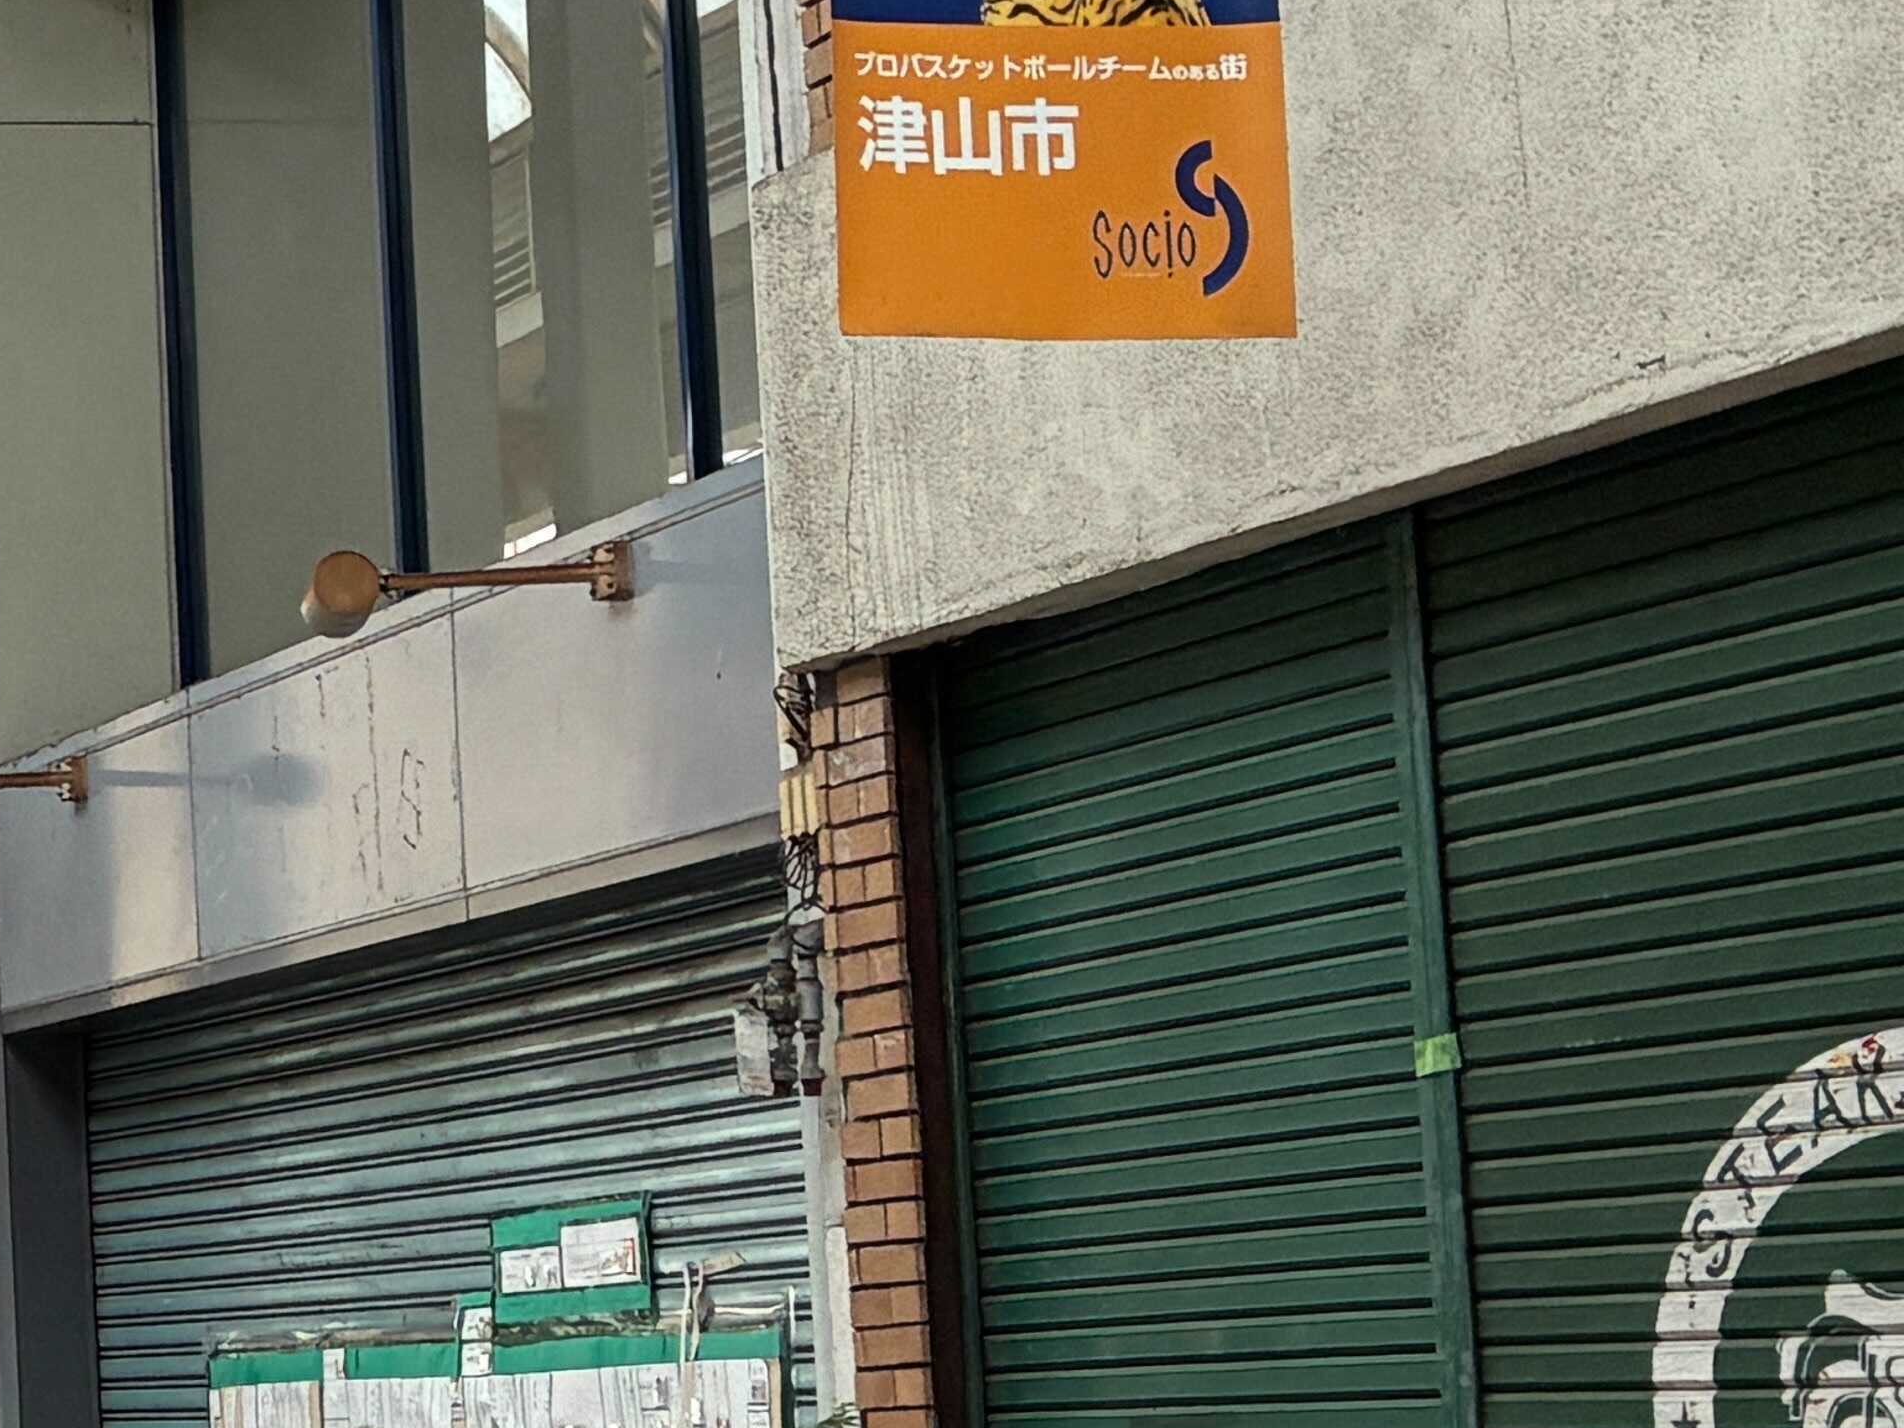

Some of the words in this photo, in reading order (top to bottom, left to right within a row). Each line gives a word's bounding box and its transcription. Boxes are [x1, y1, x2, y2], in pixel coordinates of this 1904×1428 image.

[853, 51, 1248, 82] プロバスケットボールチームのある街
[857, 95, 1080, 176] 津山市
[1093, 208, 1197, 279] Socio
